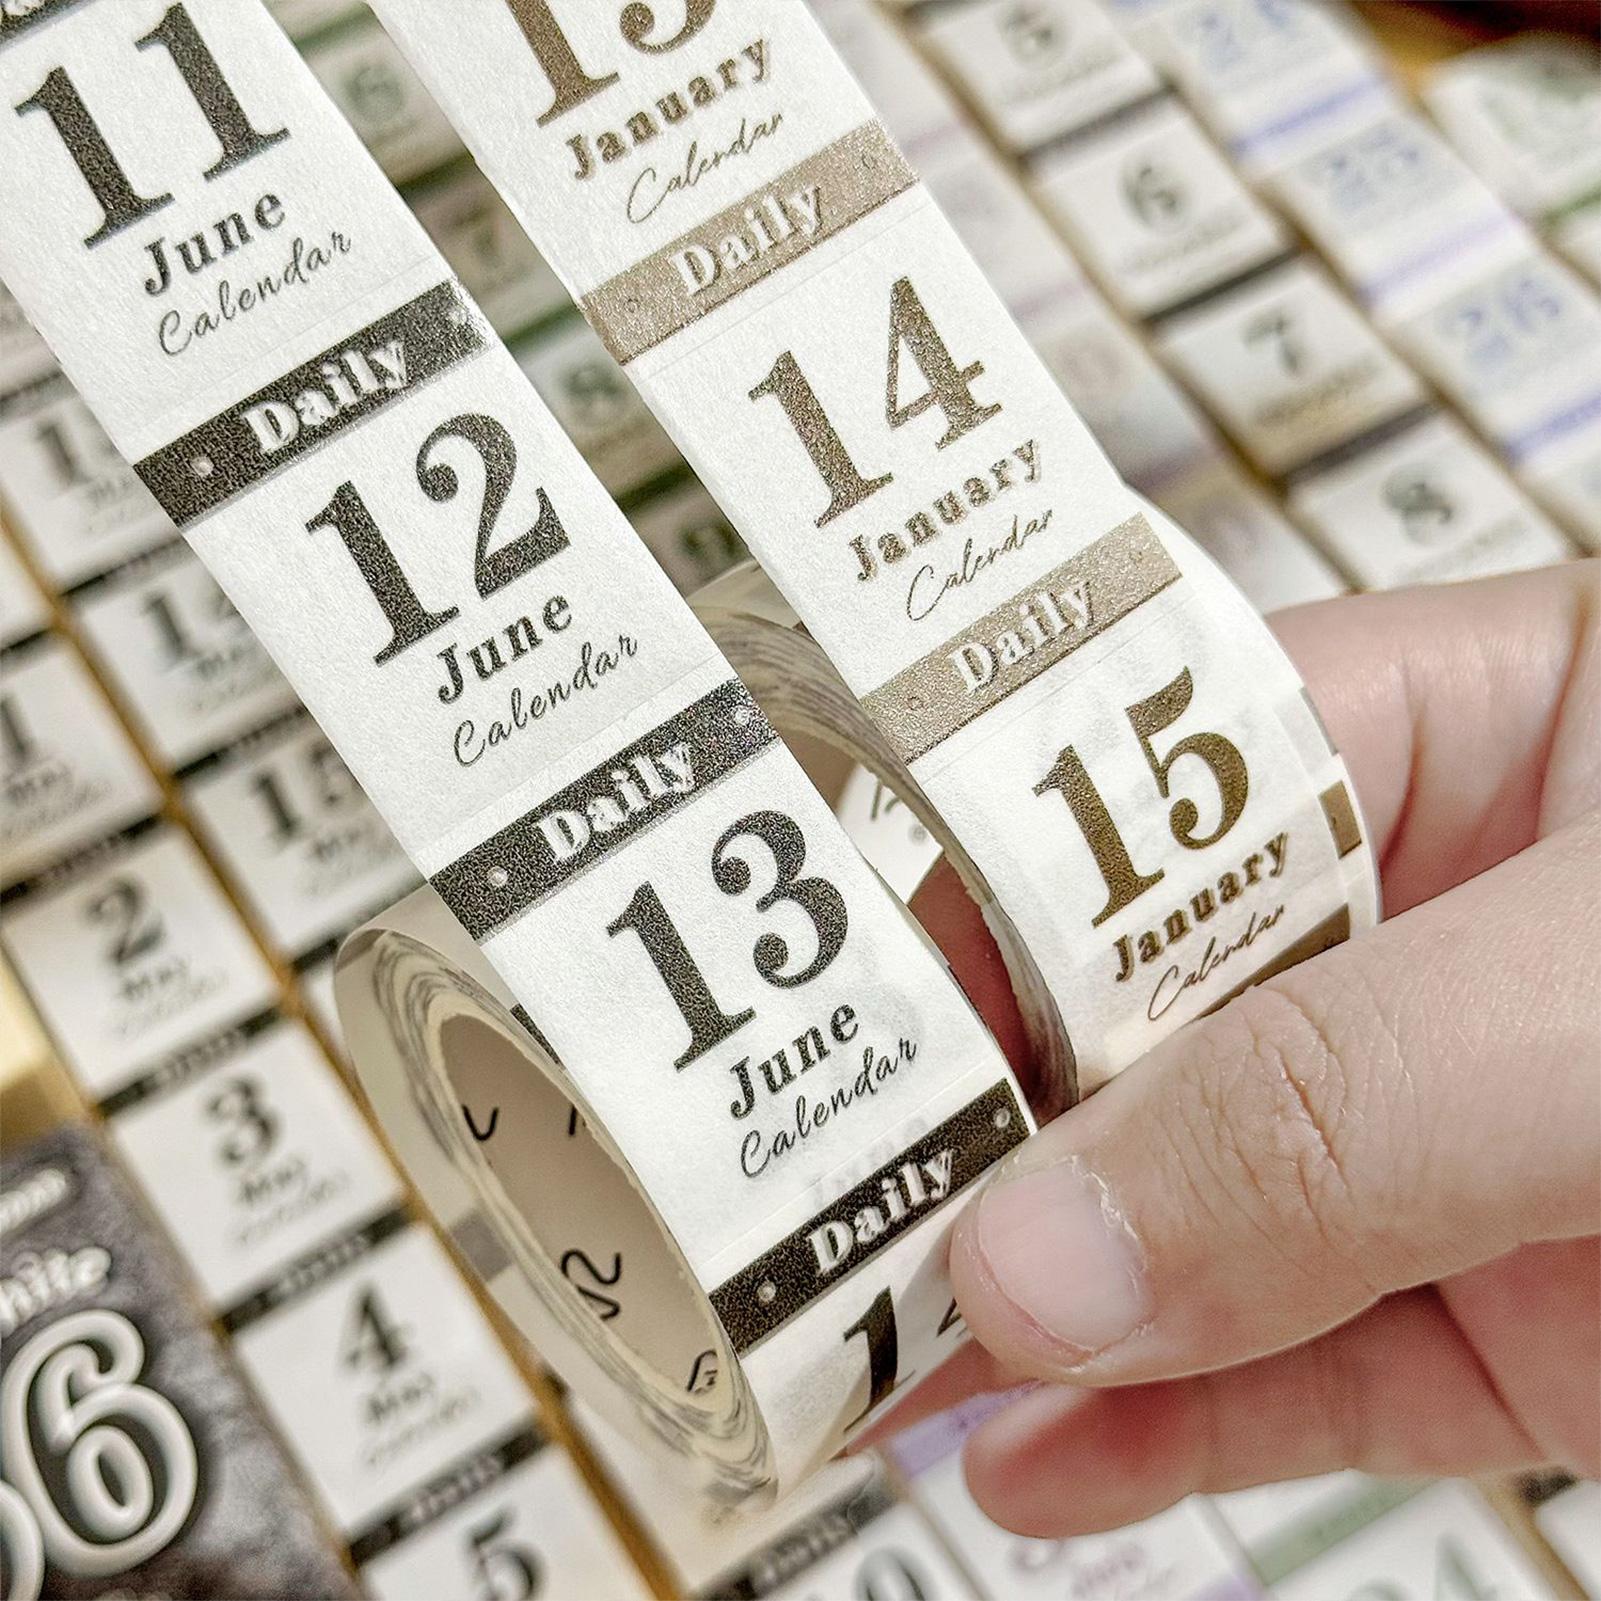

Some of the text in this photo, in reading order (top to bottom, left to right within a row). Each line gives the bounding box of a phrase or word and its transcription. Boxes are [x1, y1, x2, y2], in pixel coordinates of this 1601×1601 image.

[505, 0, 715, 128] 1
[565, 38, 771, 180] January
[15, 3, 290, 249] 11
[627, 113, 783, 223] Calendar
[143, 193, 286, 297] June
[159, 232, 352, 356] Calendar
[670, 185, 822, 296] Daily
[244, 341, 407, 454] Daily
[749, 277, 1002, 528] 14
[305, 413, 571, 666] 12
[850, 438, 1042, 581] January
[907, 509, 1052, 620] Calendar
[438, 595, 572, 704] June
[951, 582, 1096, 692] Daily
[453, 633, 638, 767] Calendar
[533, 744, 695, 864] Daily
[1033, 667, 1249, 929] 15
[82, 873, 168, 964] 2
[607, 810, 848, 1073] 13
[1113, 831, 1288, 981] January
[1148, 905, 1284, 1020] Calendar
[205, 1075, 284, 1168] 3
[729, 1004, 859, 1119] June
[740, 1038, 917, 1178] Calendar
[804, 1147, 953, 1279] Daily
[340, 1280, 410, 1372] 4
